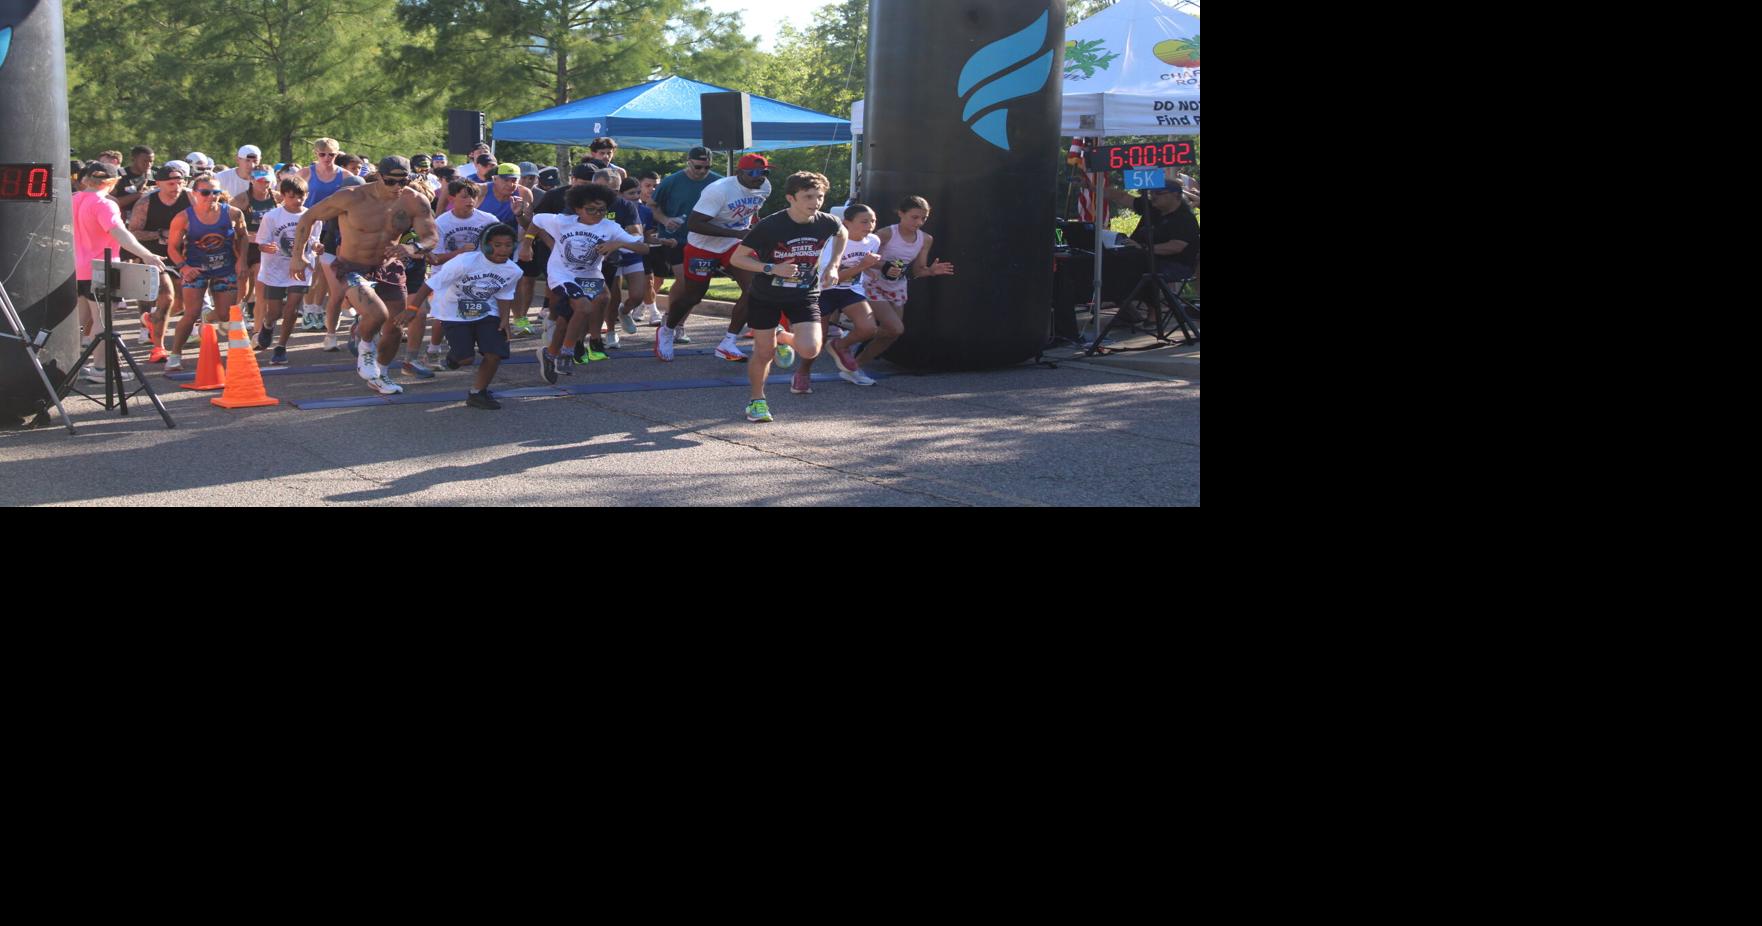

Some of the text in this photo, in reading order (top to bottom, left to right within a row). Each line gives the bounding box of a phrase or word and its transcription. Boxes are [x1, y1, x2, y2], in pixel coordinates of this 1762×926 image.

[1154, 100, 1200, 111] DO NO
[1156, 115, 1191, 126] Find
[1133, 170, 1155, 188] 5K
[791, 244, 814, 252] STATE
[581, 280, 596, 288] 126
